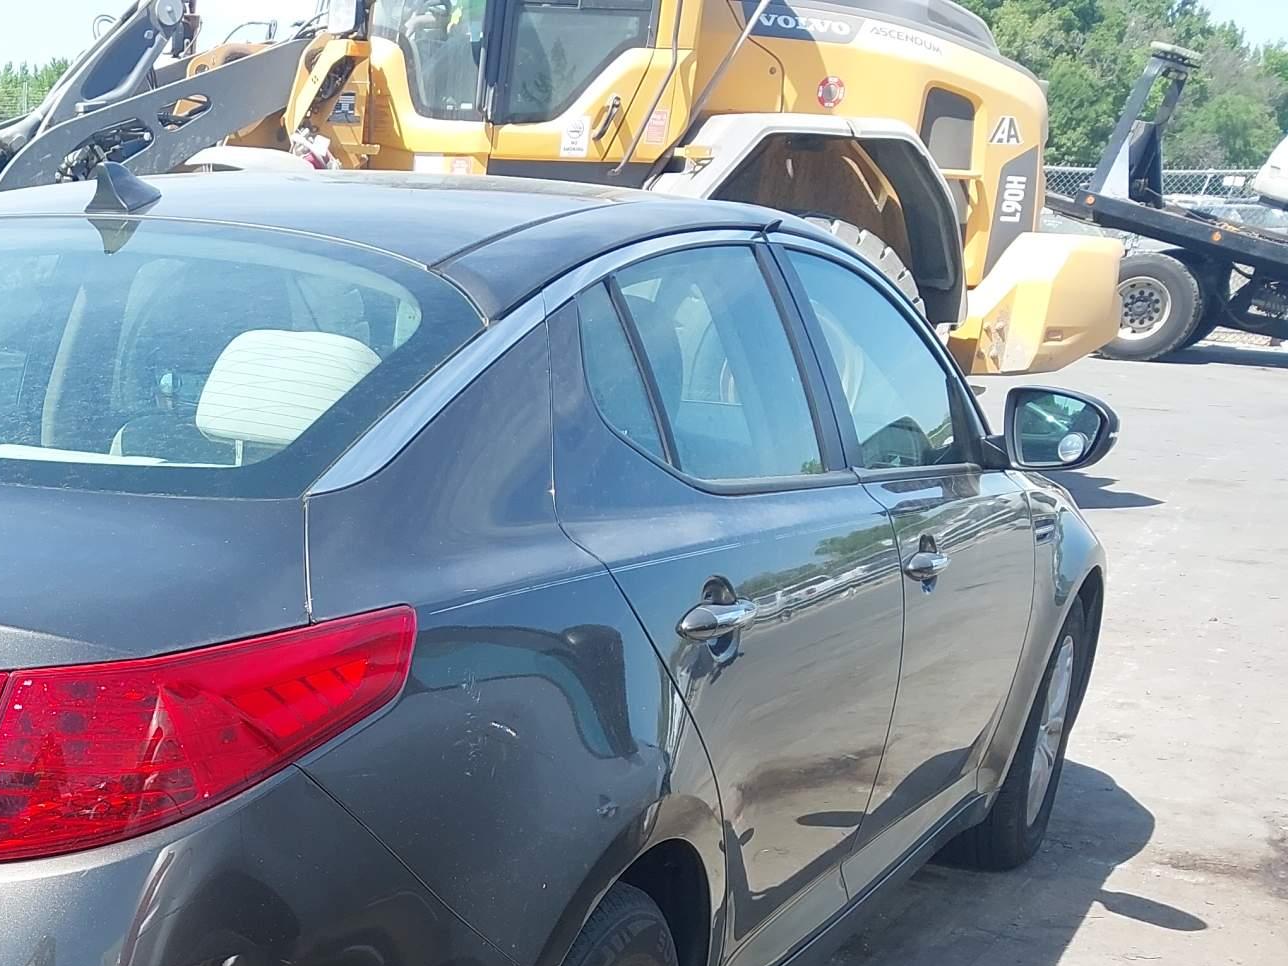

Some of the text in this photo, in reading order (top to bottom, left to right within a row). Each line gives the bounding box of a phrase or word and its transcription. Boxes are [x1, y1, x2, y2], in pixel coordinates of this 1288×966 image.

[759, 13, 851, 36] VOLVO
[869, 26, 943, 55] ASCENDUM
[999, 175, 1027, 222] L90H
